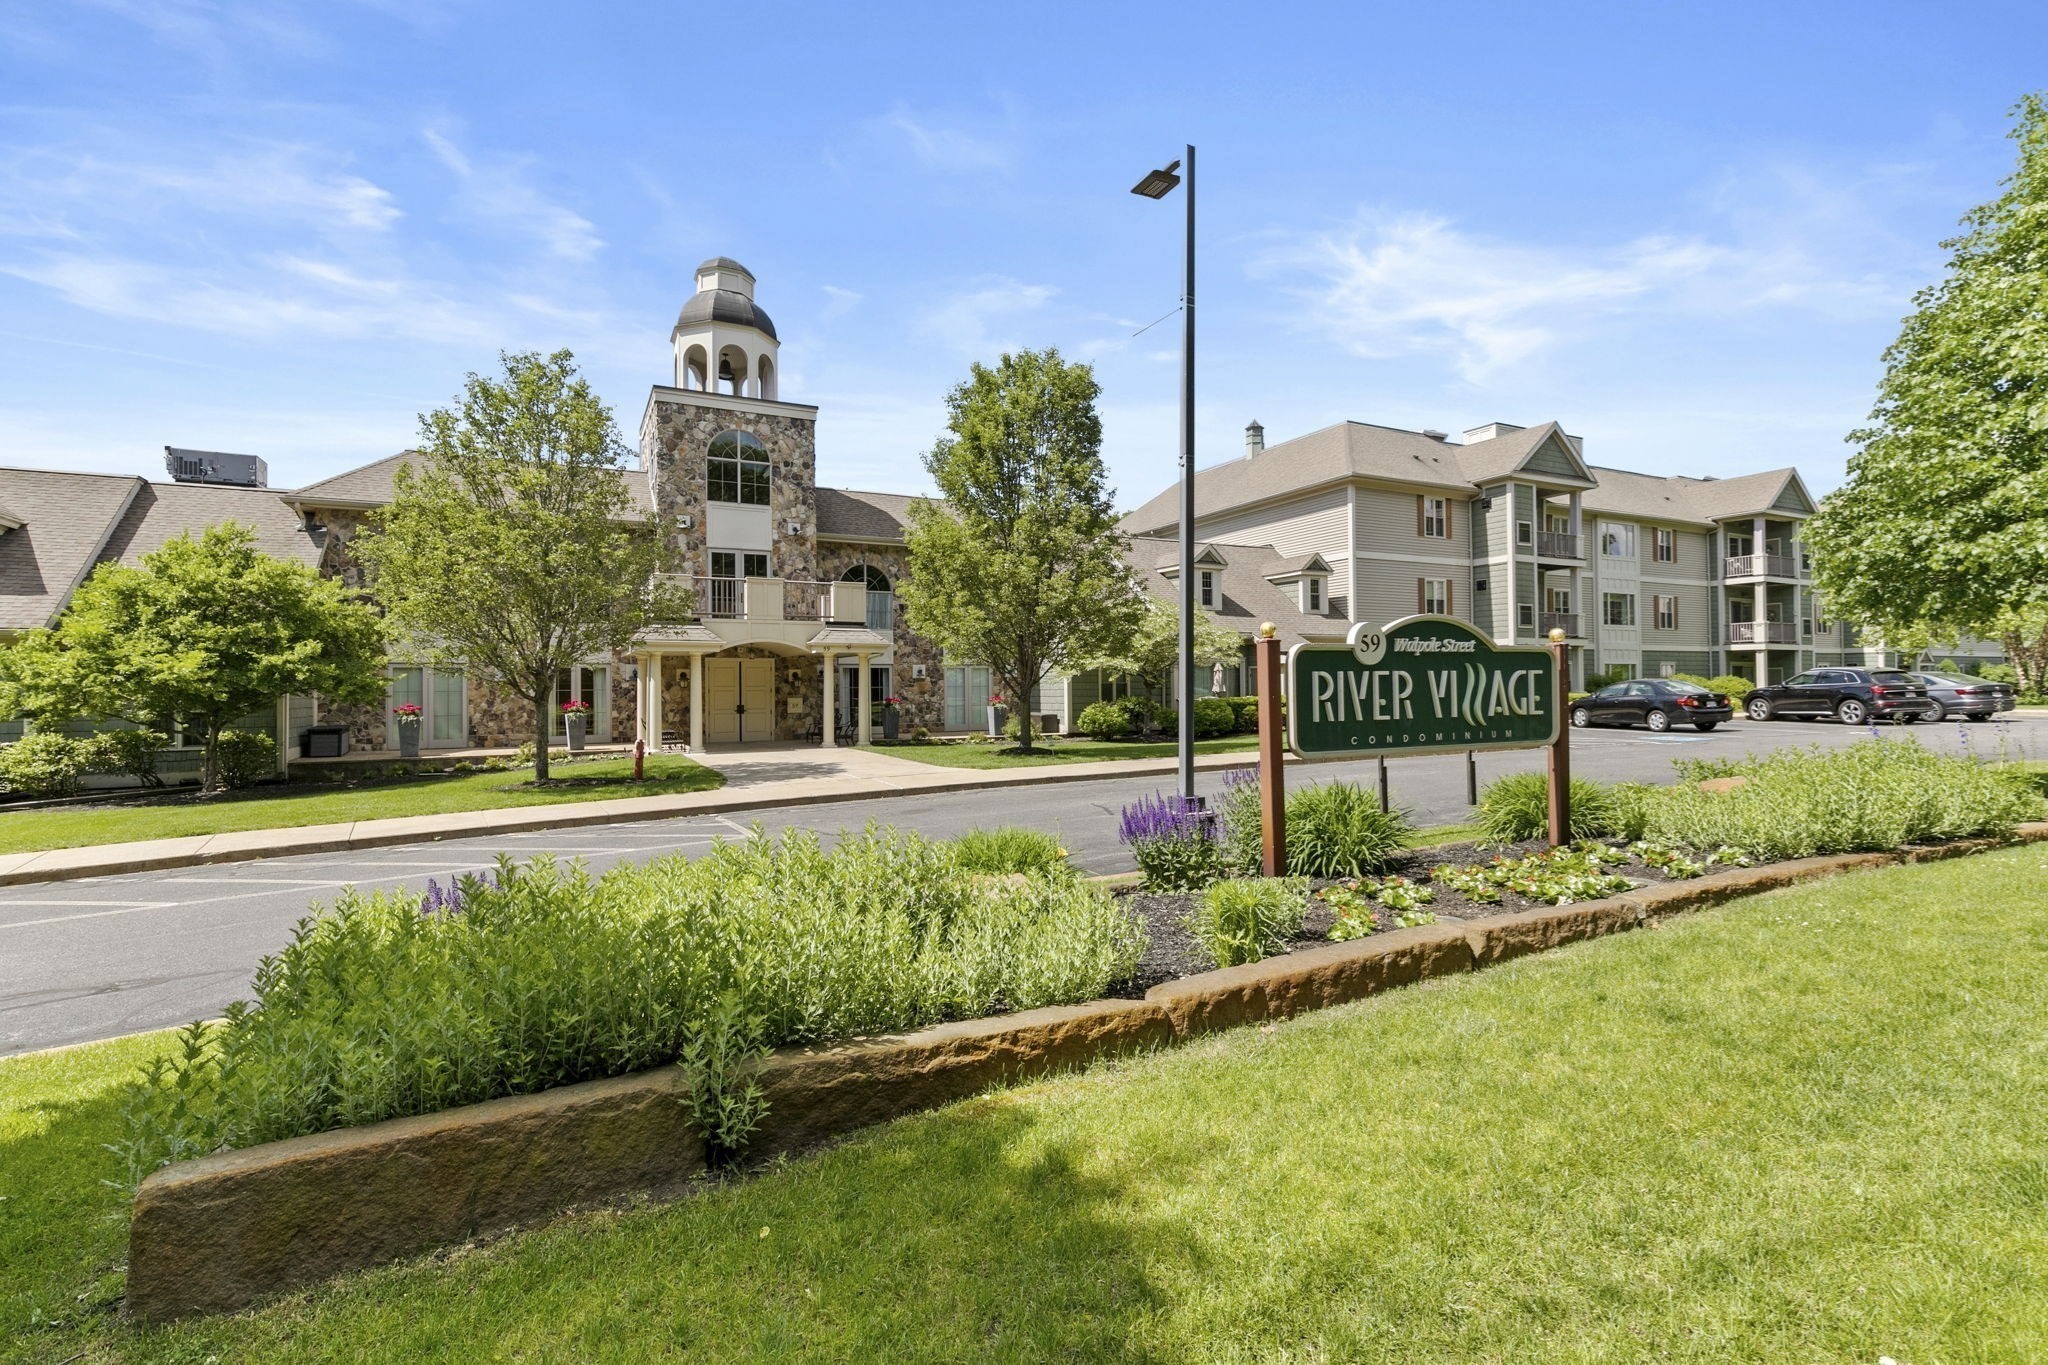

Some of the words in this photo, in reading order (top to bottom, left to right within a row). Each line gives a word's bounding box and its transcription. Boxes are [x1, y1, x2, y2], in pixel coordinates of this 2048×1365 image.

[1360, 634, 1380, 652] 59
[1394, 637, 1441, 656] Walpole
[1441, 638, 1476, 652] Street
[1311, 670, 1414, 722] RIVER
[1427, 662, 1544, 726] VILLAGE
[1350, 729, 1513, 745] CONDOMINIUM
